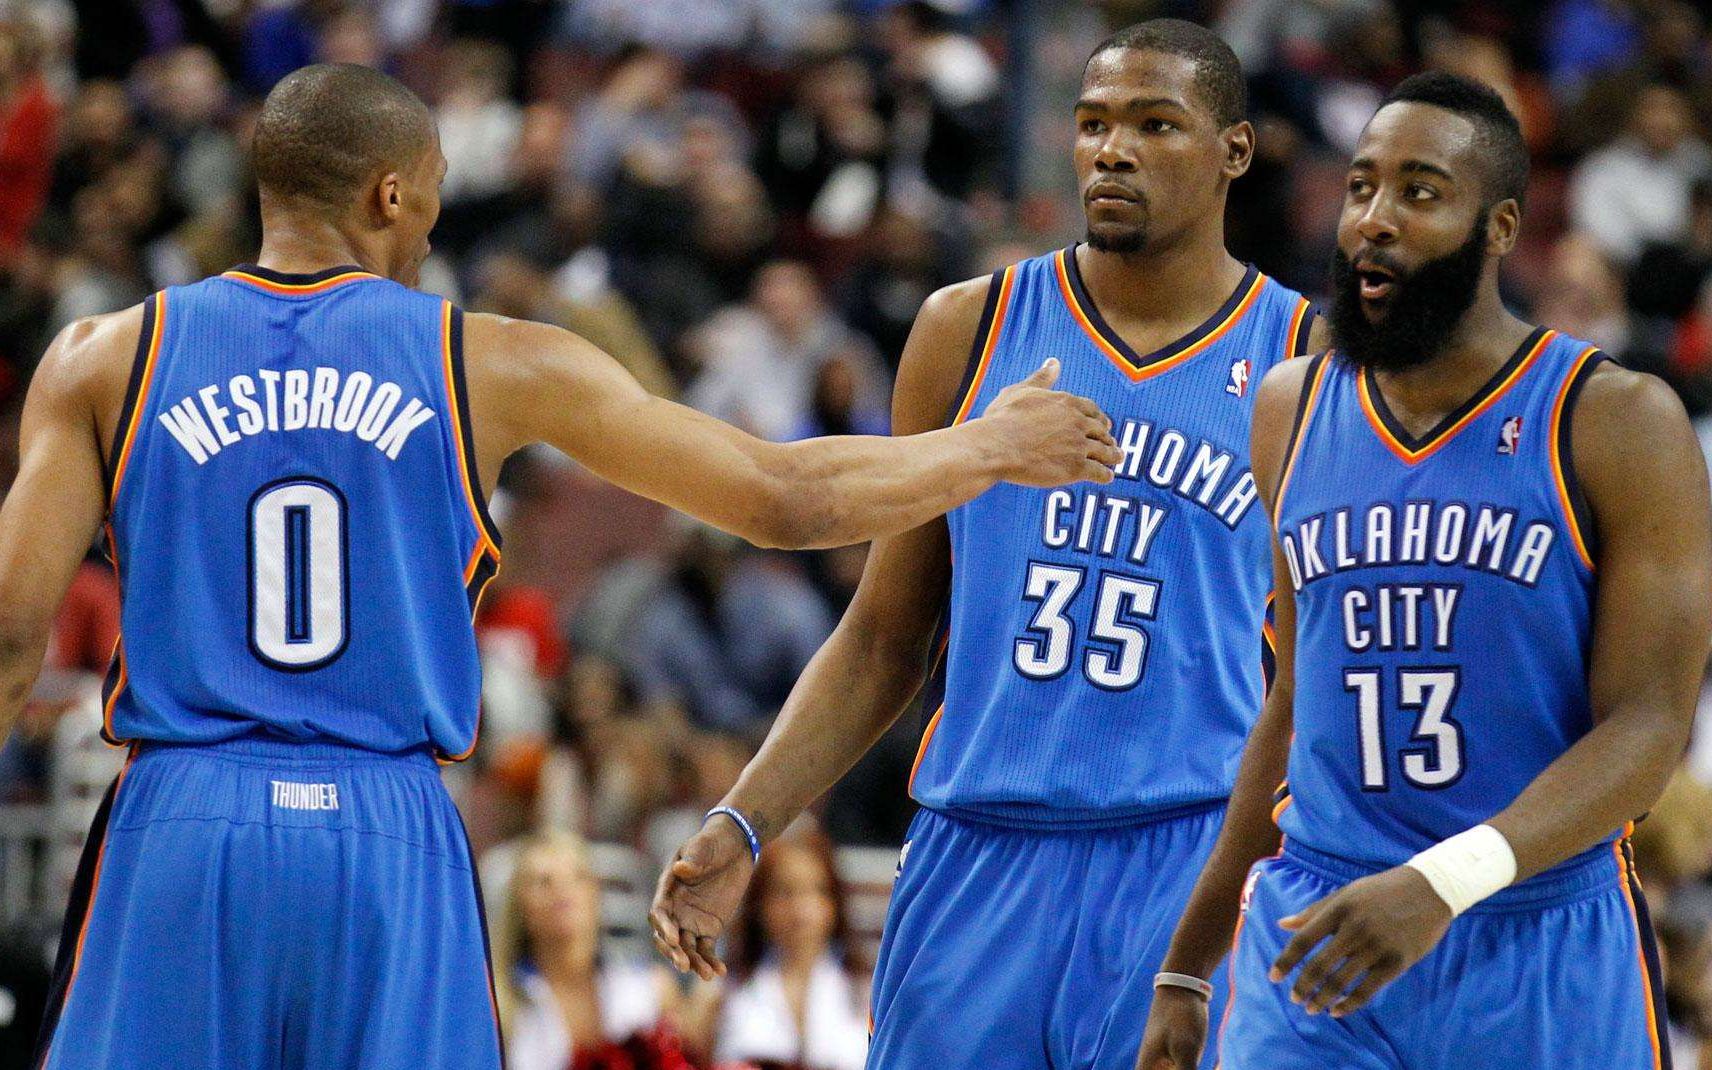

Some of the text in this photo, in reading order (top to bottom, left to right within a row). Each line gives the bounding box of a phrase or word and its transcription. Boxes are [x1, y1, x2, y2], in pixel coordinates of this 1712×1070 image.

[158, 366, 436, 466] WESTBROOK
[1113, 418, 1259, 530] HOMA
[246, 475, 349, 673] 0
[1043, 489, 1167, 564] CITY
[1282, 500, 1555, 592] OKLAHOMA
[1013, 560, 1163, 692] 35
[1341, 583, 1462, 653] CITY
[1342, 665, 1466, 792] 13
[270, 780, 340, 811] THUNDER
